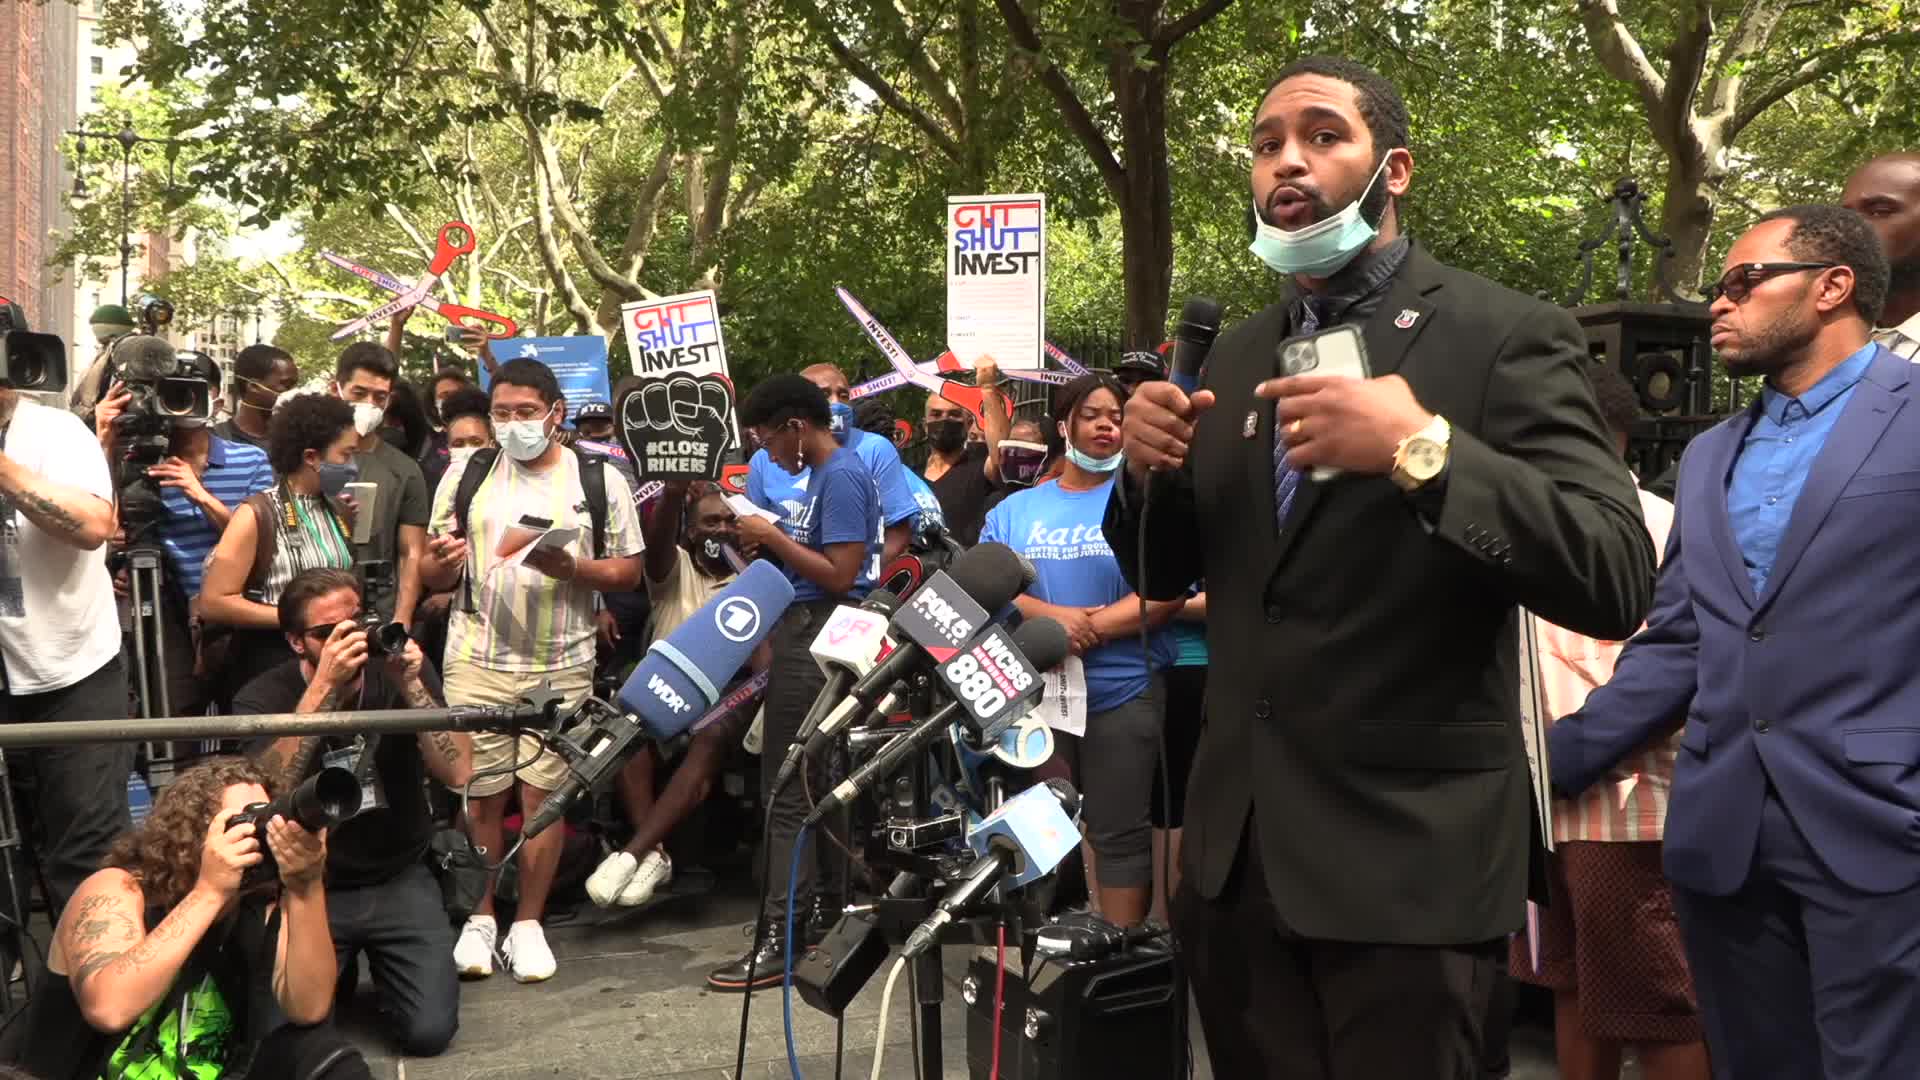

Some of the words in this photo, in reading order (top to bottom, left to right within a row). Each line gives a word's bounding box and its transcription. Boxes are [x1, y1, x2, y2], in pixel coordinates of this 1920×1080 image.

[955, 218, 1040, 251] SHUT
[954, 245, 1040, 276] INVEST
[637, 317, 714, 351] SHUT
[866, 319, 900, 359] INVEST!
[639, 341, 719, 373] INVEST
[866, 376, 896, 393] SHUT!
[580, 403, 605, 416] NYC
[646, 440, 710, 458] #CLOSE
[647, 457, 707, 474] RIKERS
[1025, 520, 1106, 547] kata
[1025, 546, 1058, 556] CENTER
[1061, 545, 1079, 554] FOR
[1081, 543, 1109, 552] EQUIT
[1061, 552, 1079, 561] AND
[911, 600, 933, 621] NEW
[933, 620, 960, 647] YORK
[916, 586, 961, 630] FOX
[951, 618, 973, 639] 5
[972, 645, 1018, 700] NEWSRADIO
[981, 632, 1033, 692] WCBS
[945, 654, 1007, 719] 880
